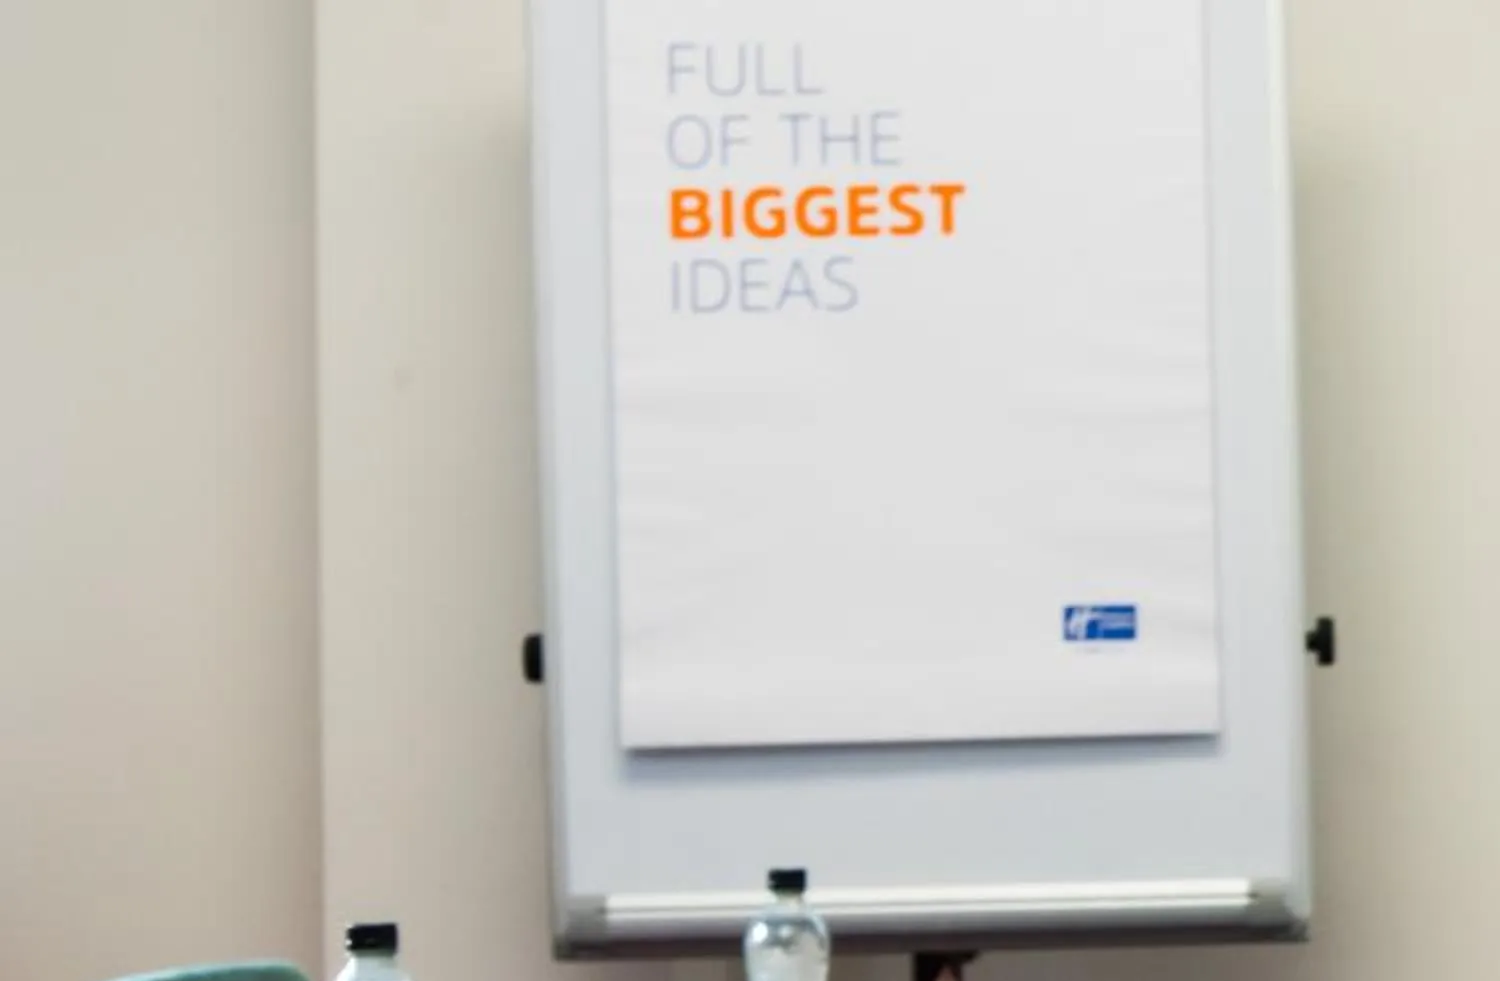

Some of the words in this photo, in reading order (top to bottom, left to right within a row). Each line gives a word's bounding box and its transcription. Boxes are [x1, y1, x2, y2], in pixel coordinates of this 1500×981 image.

[667, 42, 823, 97] FULL
[666, 114, 749, 170] OF
[779, 111, 900, 166] THE
[669, 183, 966, 240] BIGGEST
[669, 256, 859, 314] IDEAS
